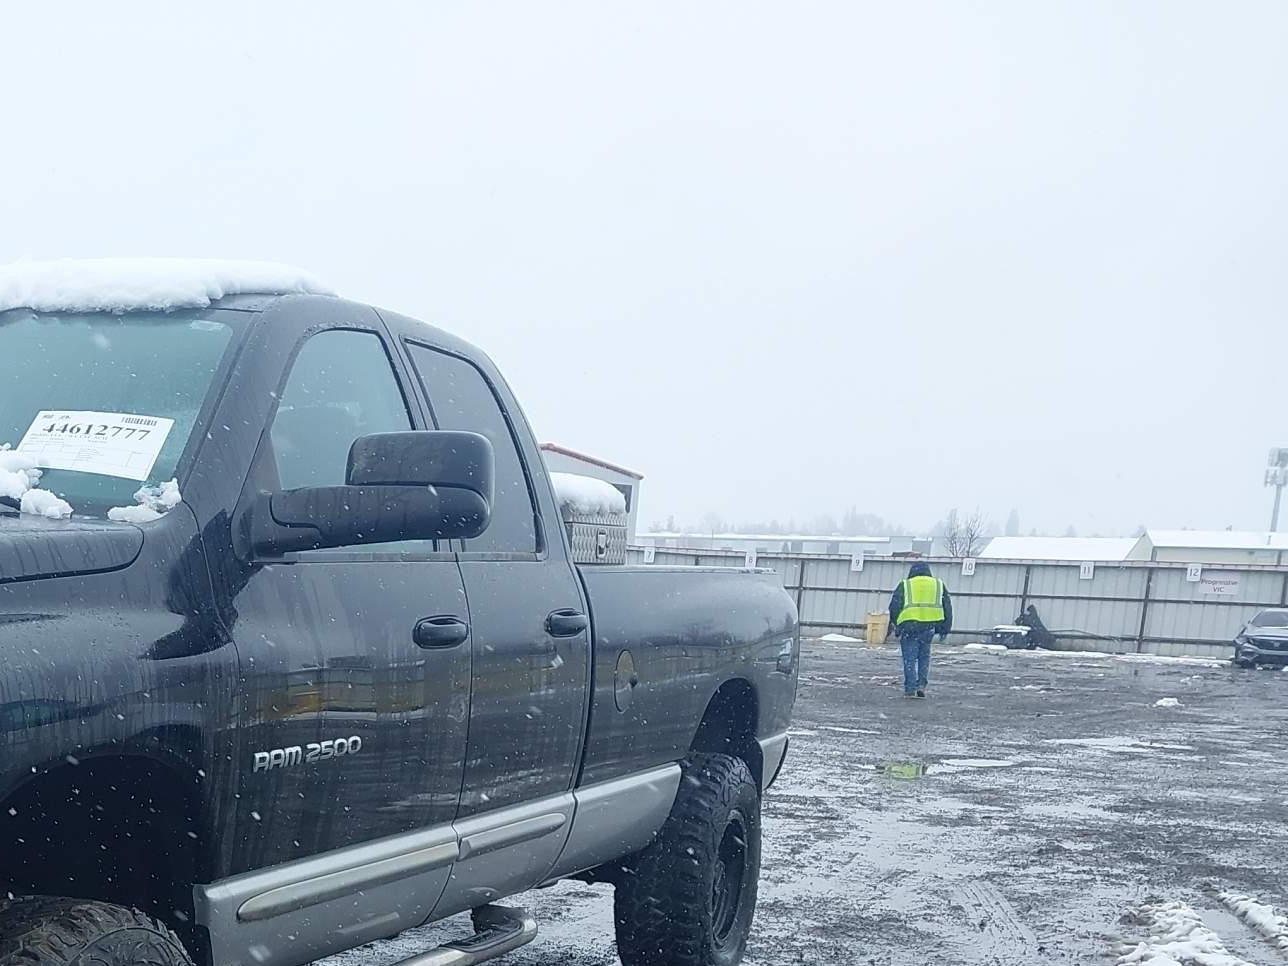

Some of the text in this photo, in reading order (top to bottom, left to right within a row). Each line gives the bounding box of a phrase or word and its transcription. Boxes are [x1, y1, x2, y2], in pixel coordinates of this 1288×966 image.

[42, 423, 151, 441] 44612777
[964, 561, 973, 571] 10
[1082, 565, 1091, 575] 11
[1189, 568, 1199, 577] 12
[253, 735, 362, 773] RAM 2500
